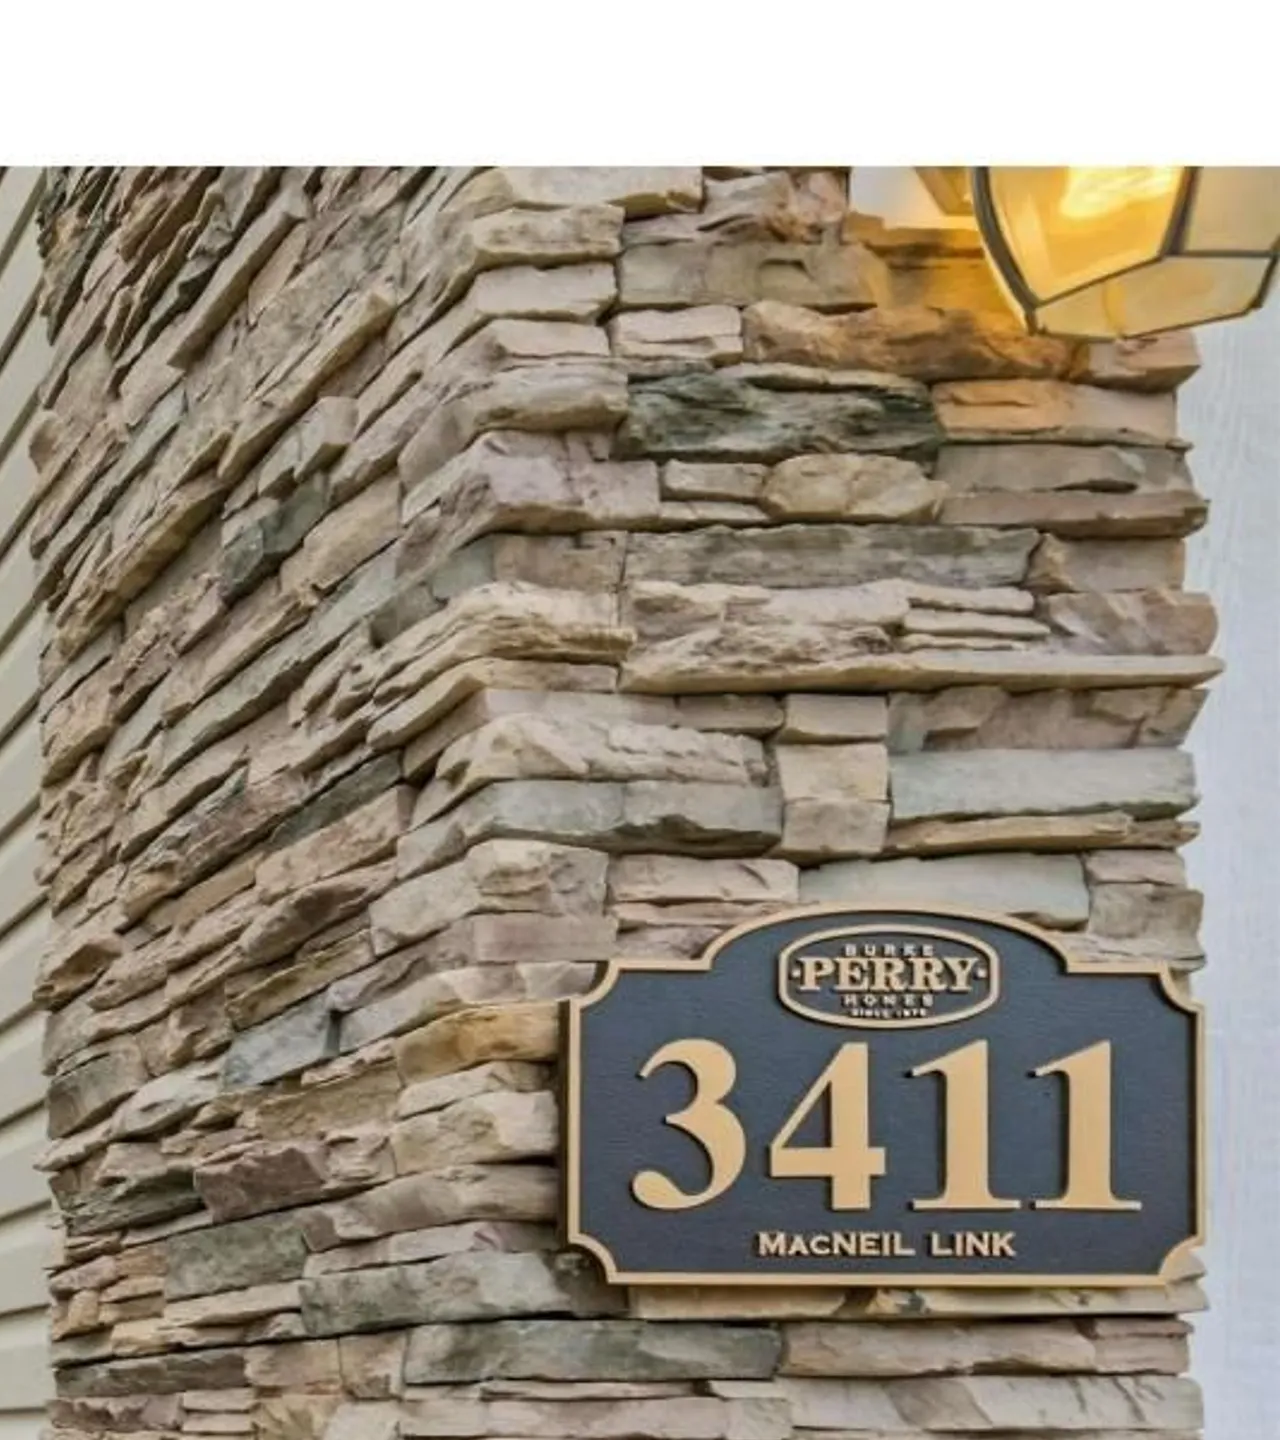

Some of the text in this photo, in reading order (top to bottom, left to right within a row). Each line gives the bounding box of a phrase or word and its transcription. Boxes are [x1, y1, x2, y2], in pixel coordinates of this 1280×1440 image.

[797, 956, 980, 992] PERRY
[631, 1037, 1143, 1211] 3411
[930, 1231, 1018, 1258] LINK
